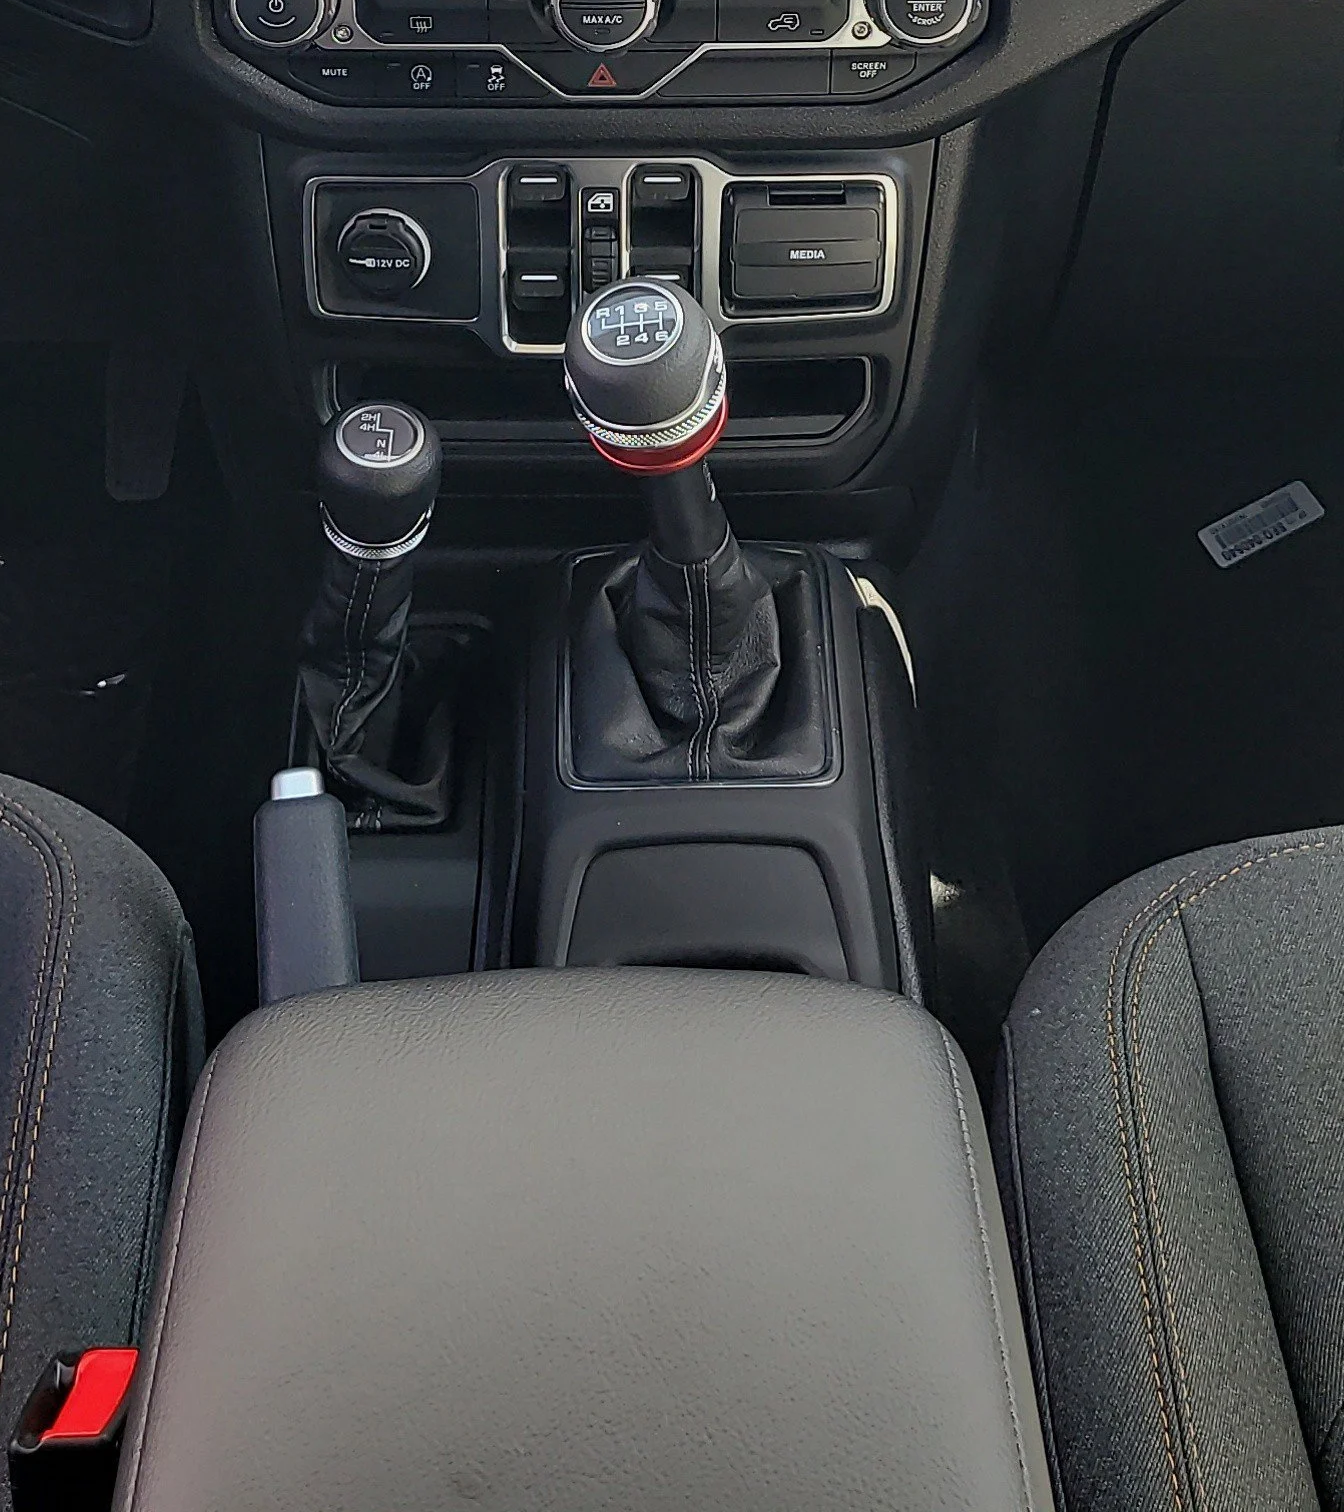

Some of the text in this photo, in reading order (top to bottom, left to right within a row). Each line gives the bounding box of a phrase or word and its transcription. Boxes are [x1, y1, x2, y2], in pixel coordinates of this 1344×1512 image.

[912, 3, 943, 12] ENTER
[582, 15, 623, 24] MAX A/C
[911, 16, 943, 26] SCROLL
[851, 62, 887, 71] SCREEN
[321, 68, 348, 77] MUTE
[859, 70, 877, 79] OFF
[413, 82, 431, 90] OFF
[487, 82, 506, 91] OFF
[789, 249, 826, 260] MEDIA
[376, 258, 410, 268] 12V DC
[595, 307, 611, 320] R
[614, 305, 625, 316] 1
[616, 334, 631, 346] 2
[634, 332, 649, 344] 4
[360, 413, 377, 422] 2H
[359, 423, 376, 432] 4H
[376, 439, 387, 448] N
